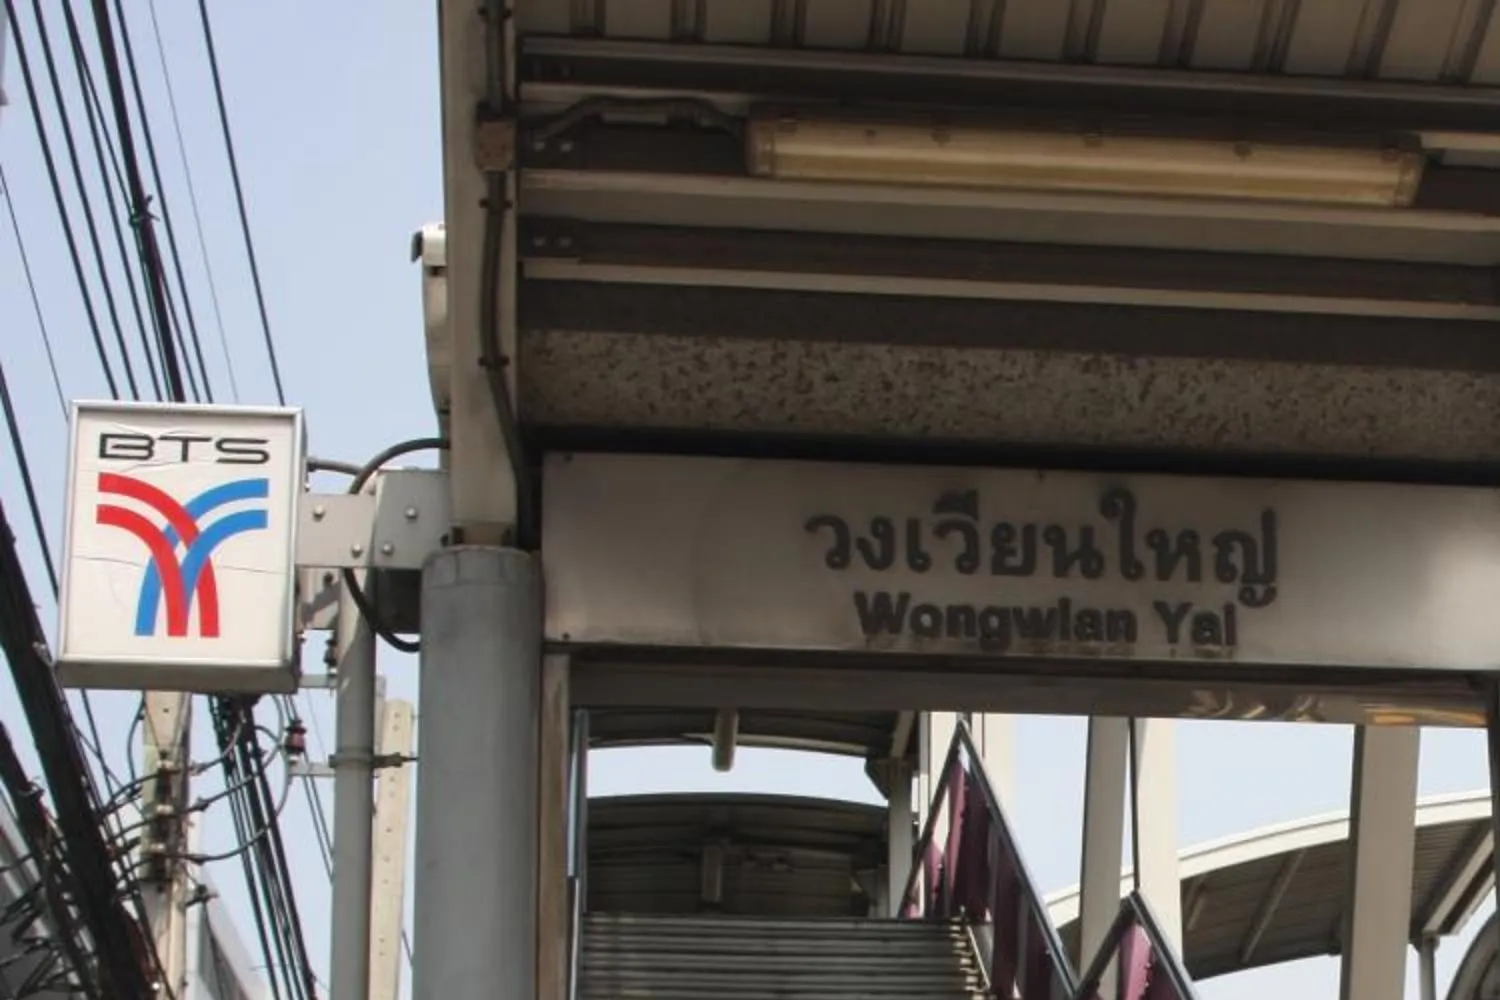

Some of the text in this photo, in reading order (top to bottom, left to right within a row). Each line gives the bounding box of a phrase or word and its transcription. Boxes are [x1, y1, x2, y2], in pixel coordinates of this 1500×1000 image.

[98, 432, 270, 465] BTS
[803, 487, 1278, 608] วงเวียนใหญ่
[853, 591, 1138, 652] Wongwian
